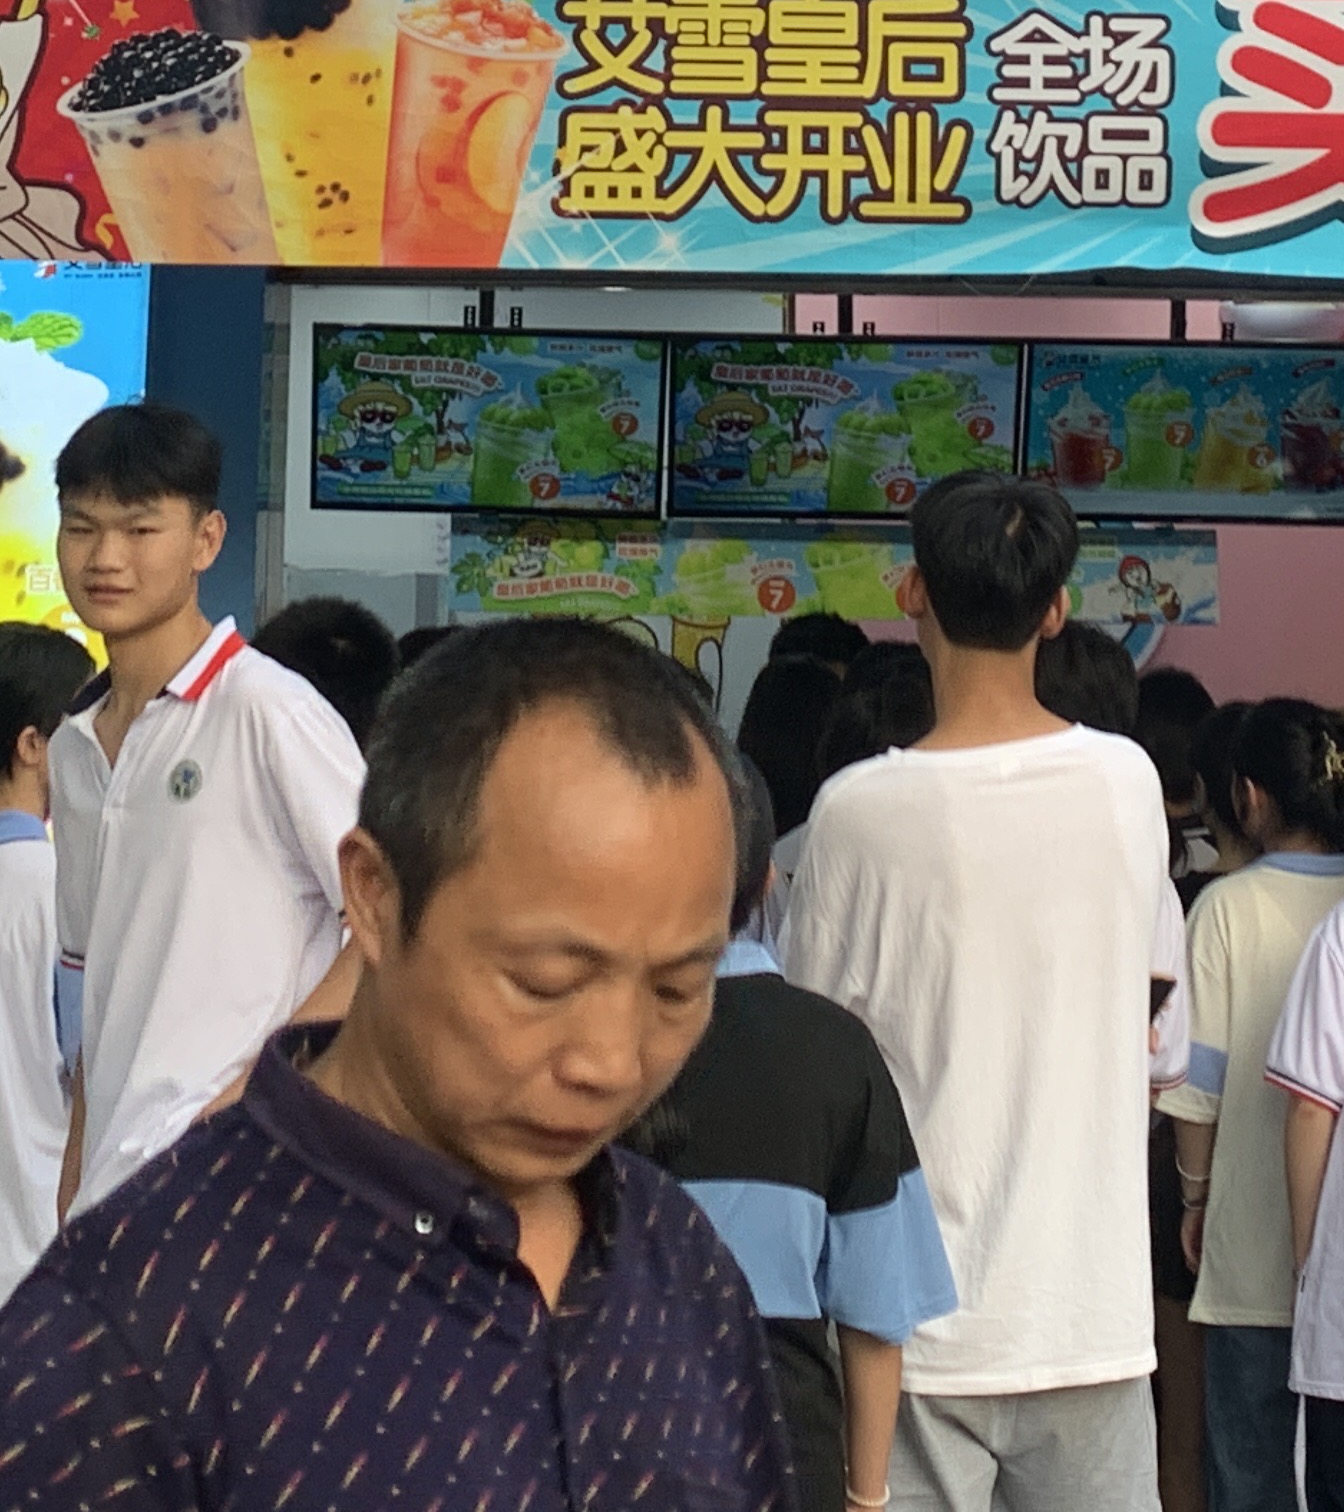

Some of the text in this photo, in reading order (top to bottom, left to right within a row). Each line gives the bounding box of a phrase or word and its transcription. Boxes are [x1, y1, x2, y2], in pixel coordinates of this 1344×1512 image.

[989, 13, 1170, 106] 全场
[556, 104, 968, 220] 盛大开业
[989, 110, 1167, 205] 饮品
[768, 588, 785, 610] 7
